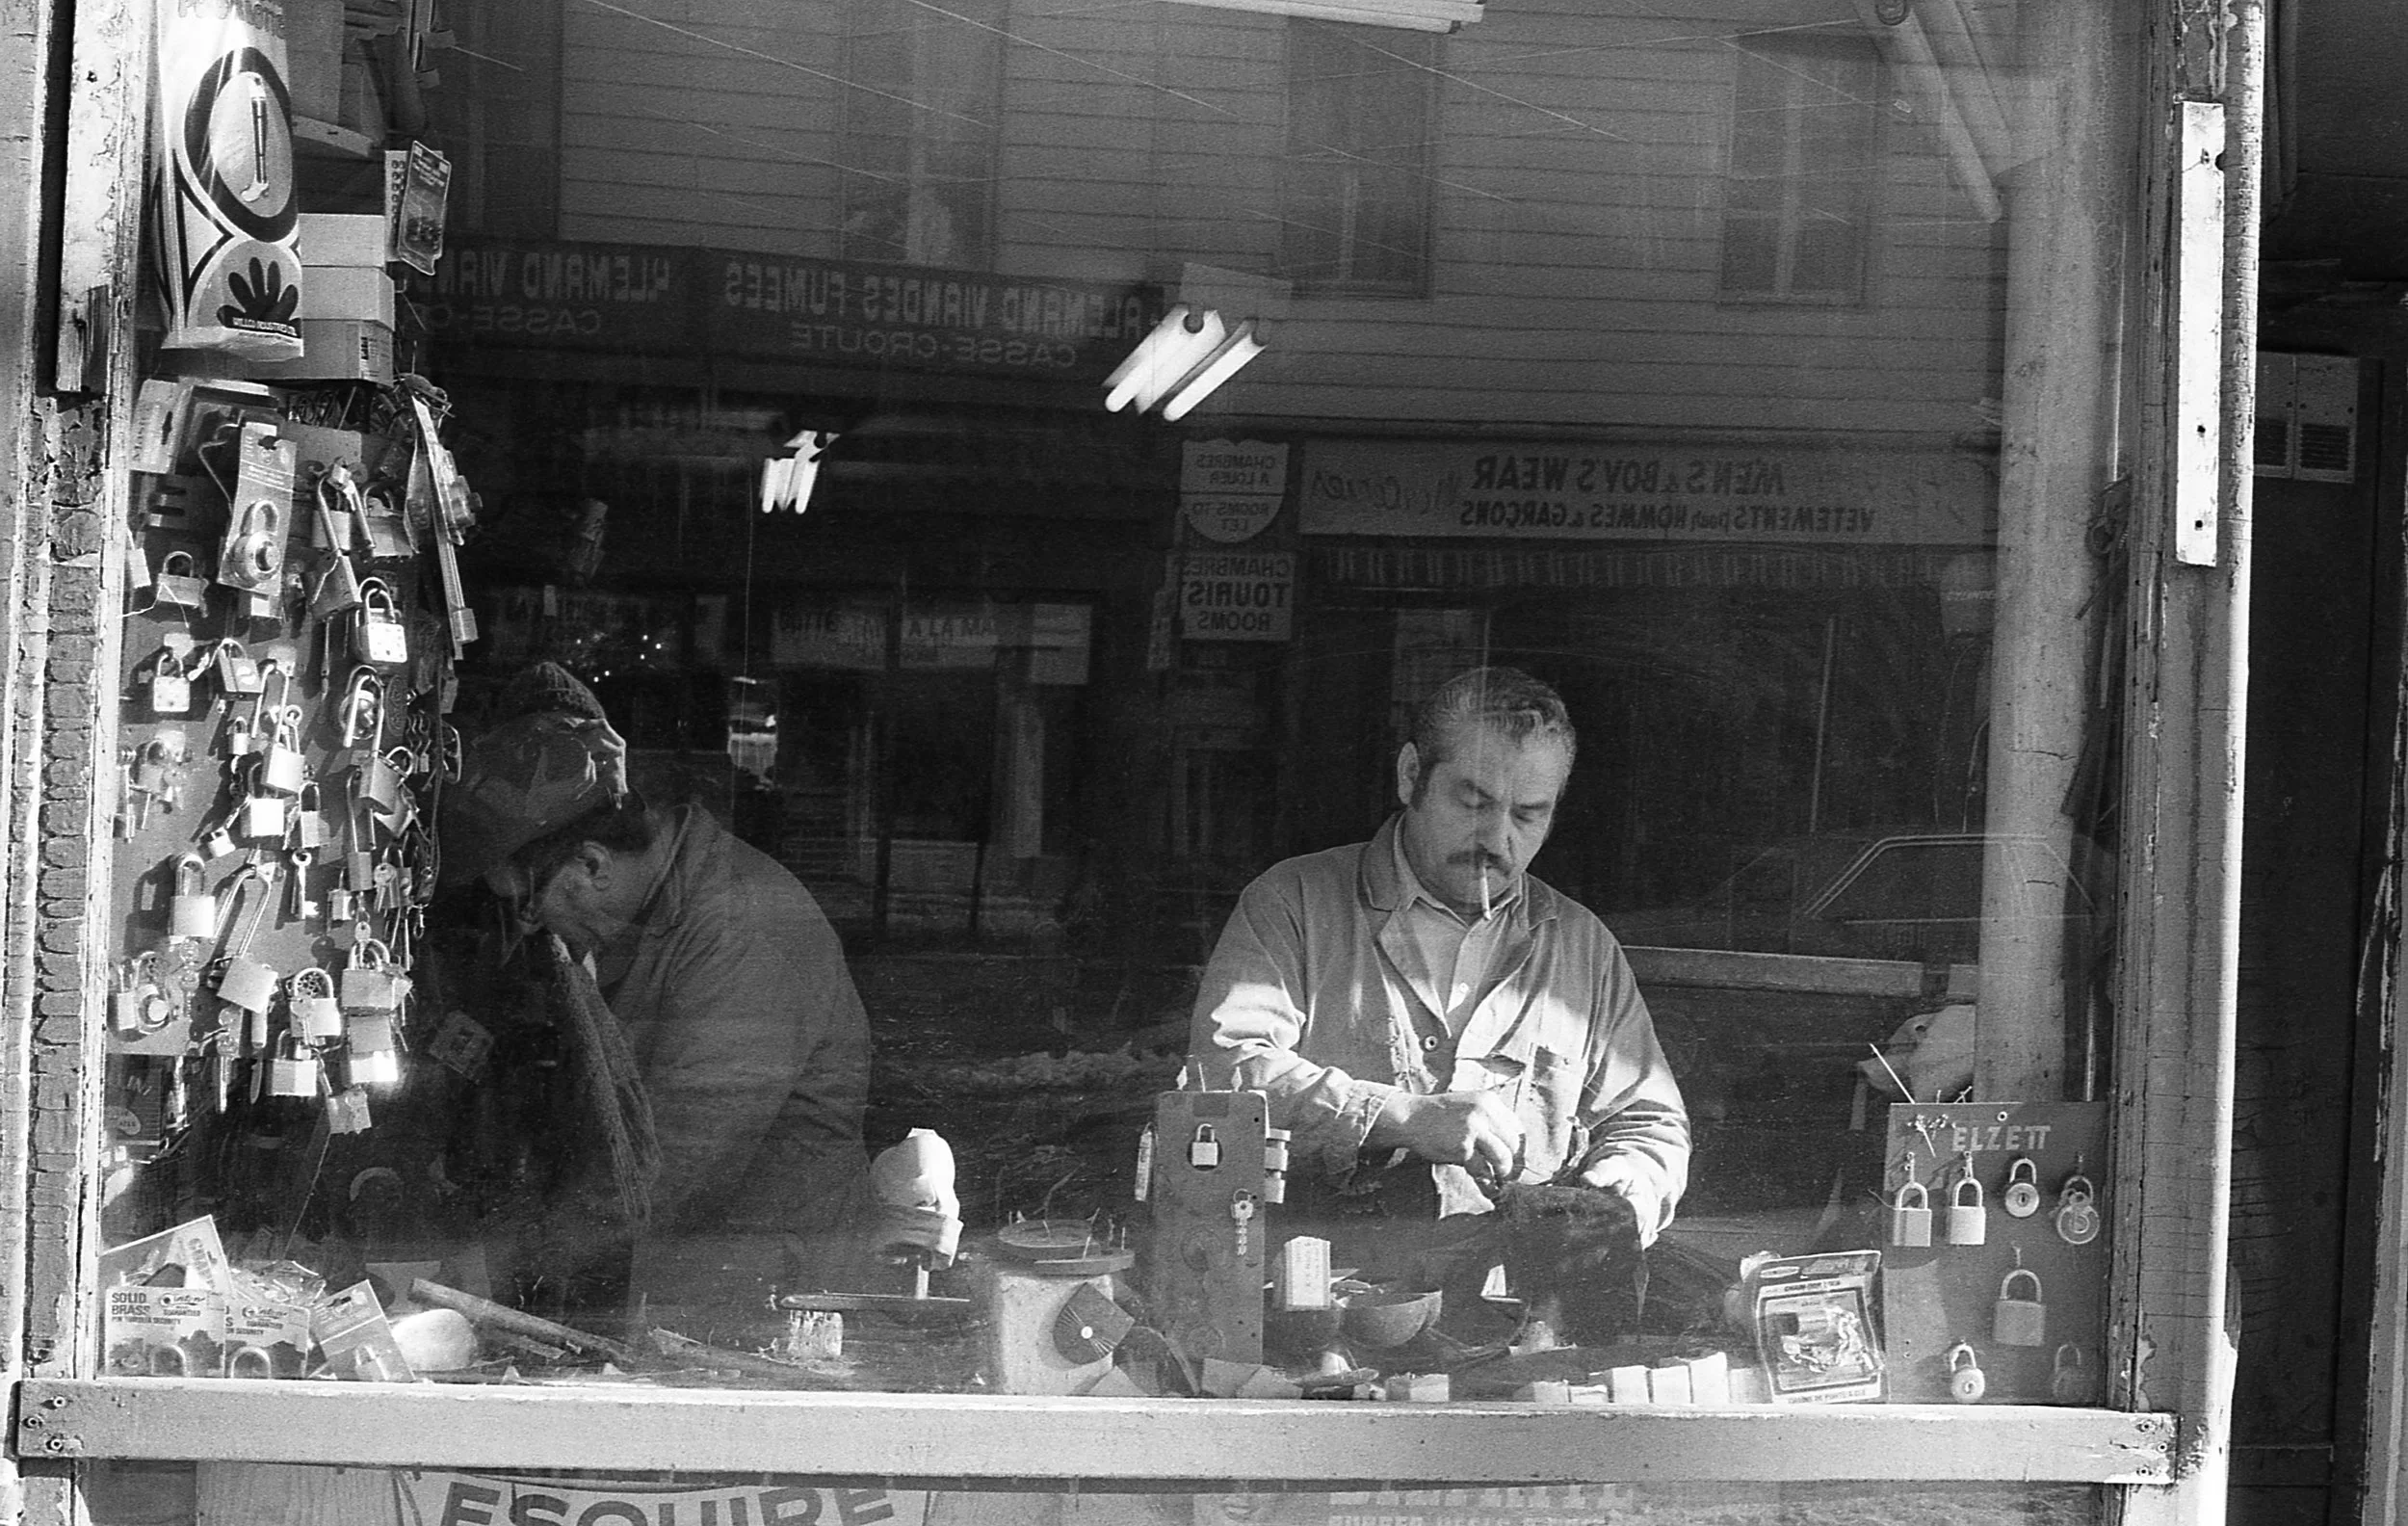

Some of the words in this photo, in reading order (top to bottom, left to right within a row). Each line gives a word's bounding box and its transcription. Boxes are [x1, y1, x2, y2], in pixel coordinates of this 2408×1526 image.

[1951, 1124, 2052, 1151] ELZETT
[112, 1292, 148, 1303] SOLID
[112, 1304, 151, 1316] BRASS
